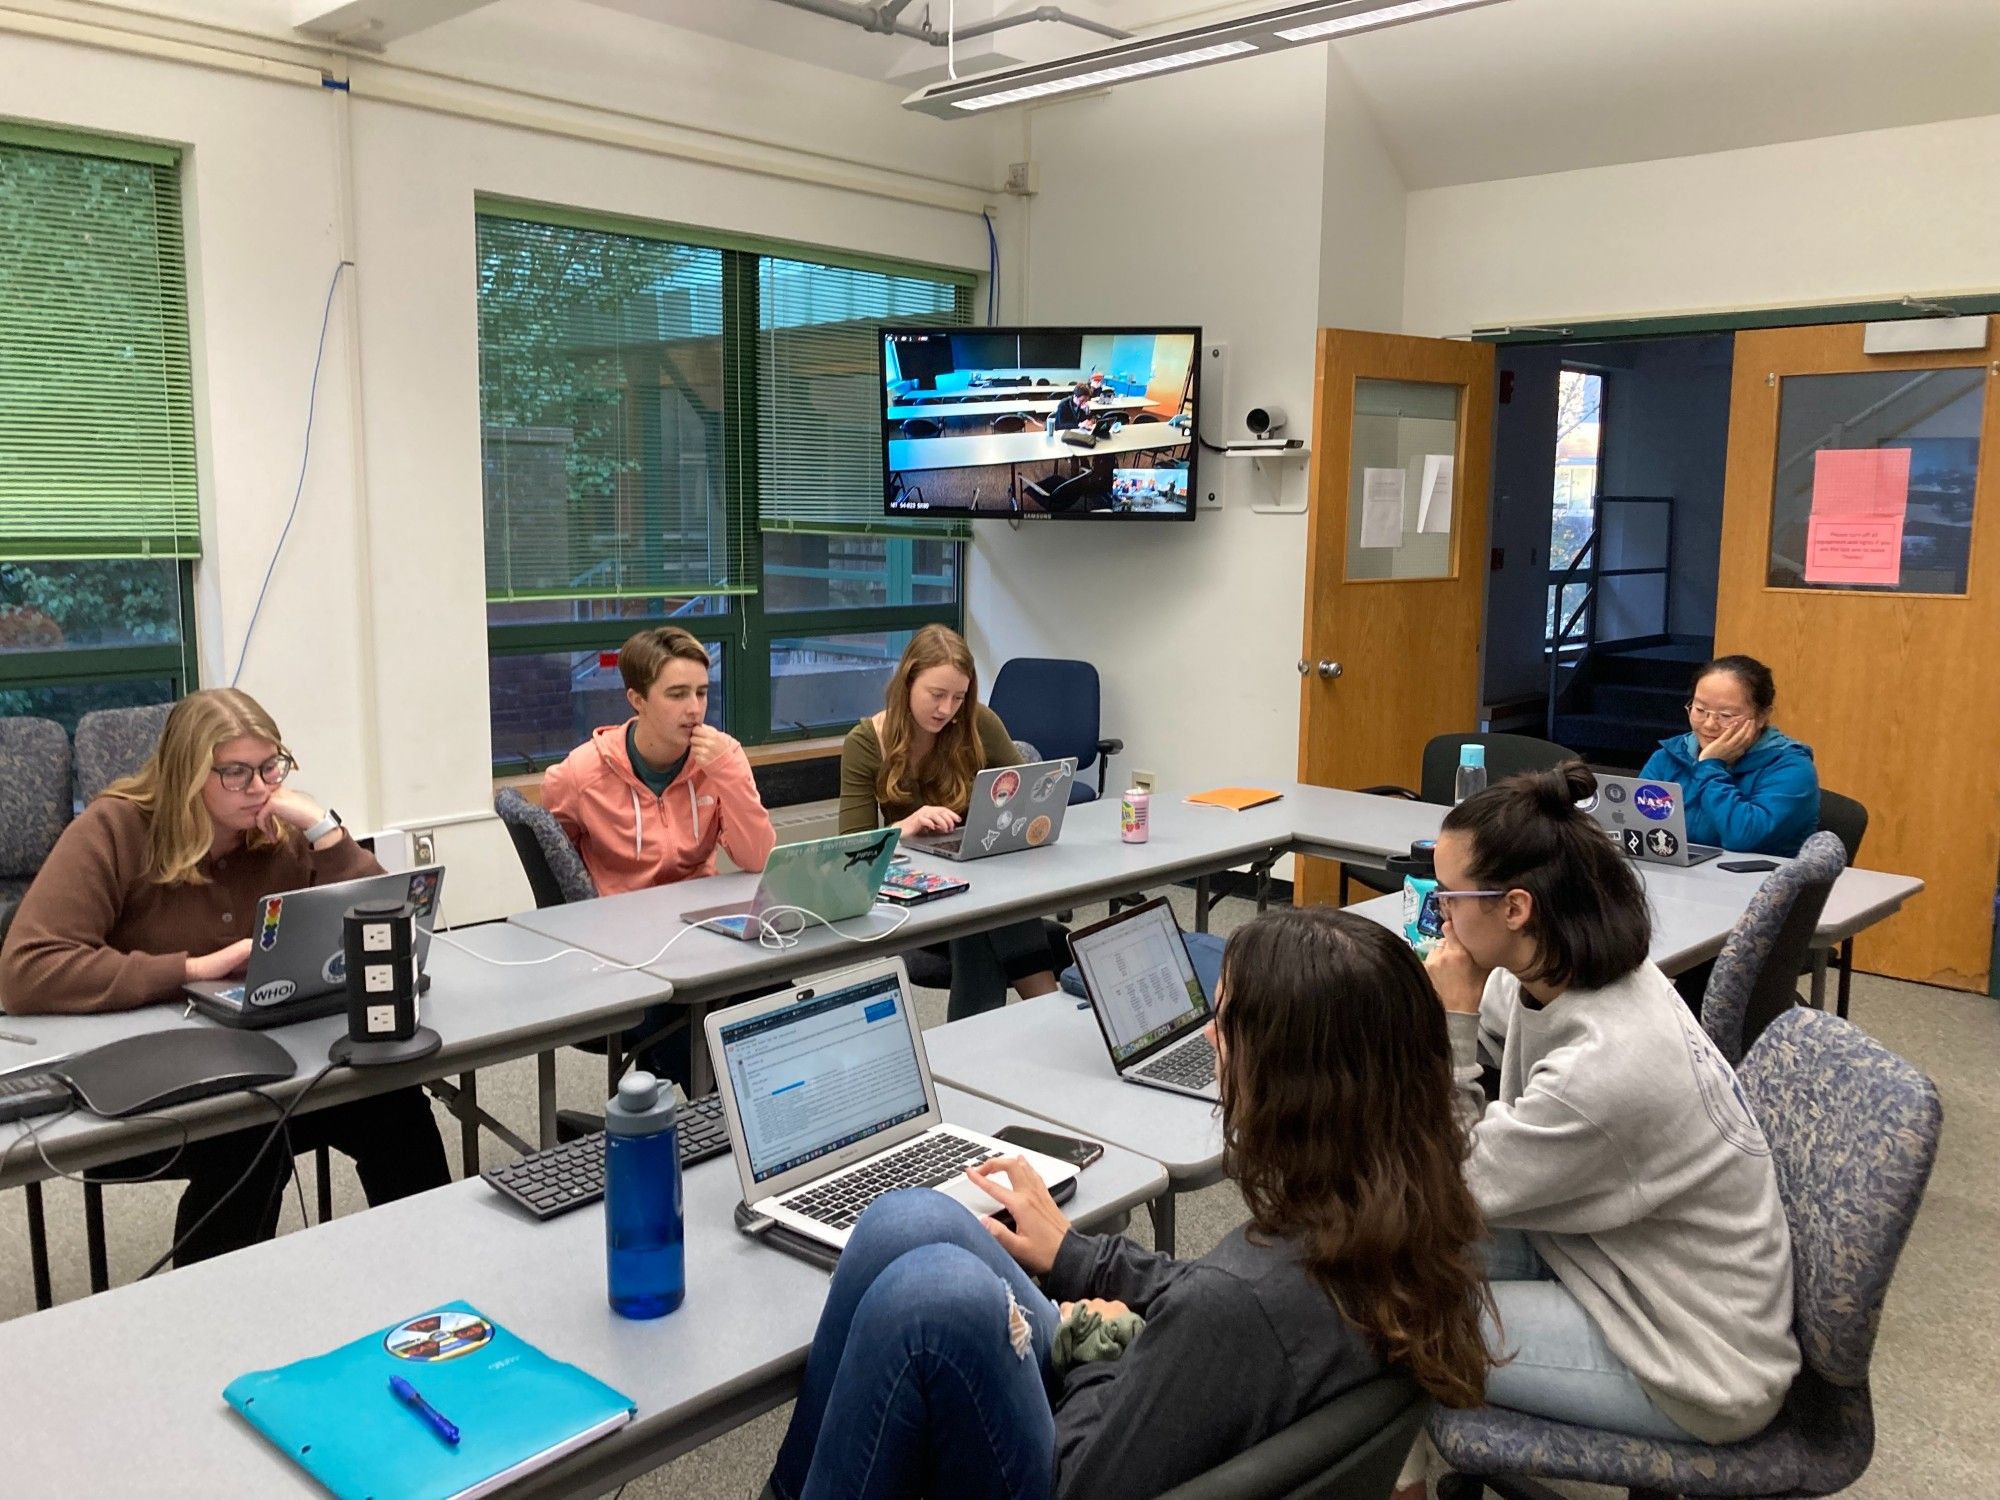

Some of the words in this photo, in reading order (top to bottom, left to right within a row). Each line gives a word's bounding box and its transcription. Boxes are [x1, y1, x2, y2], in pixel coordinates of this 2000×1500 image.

[1023, 512, 1052, 520] SAMSUNG
[1637, 796, 1672, 809] NASA
[254, 983, 293, 1002] WHOI
